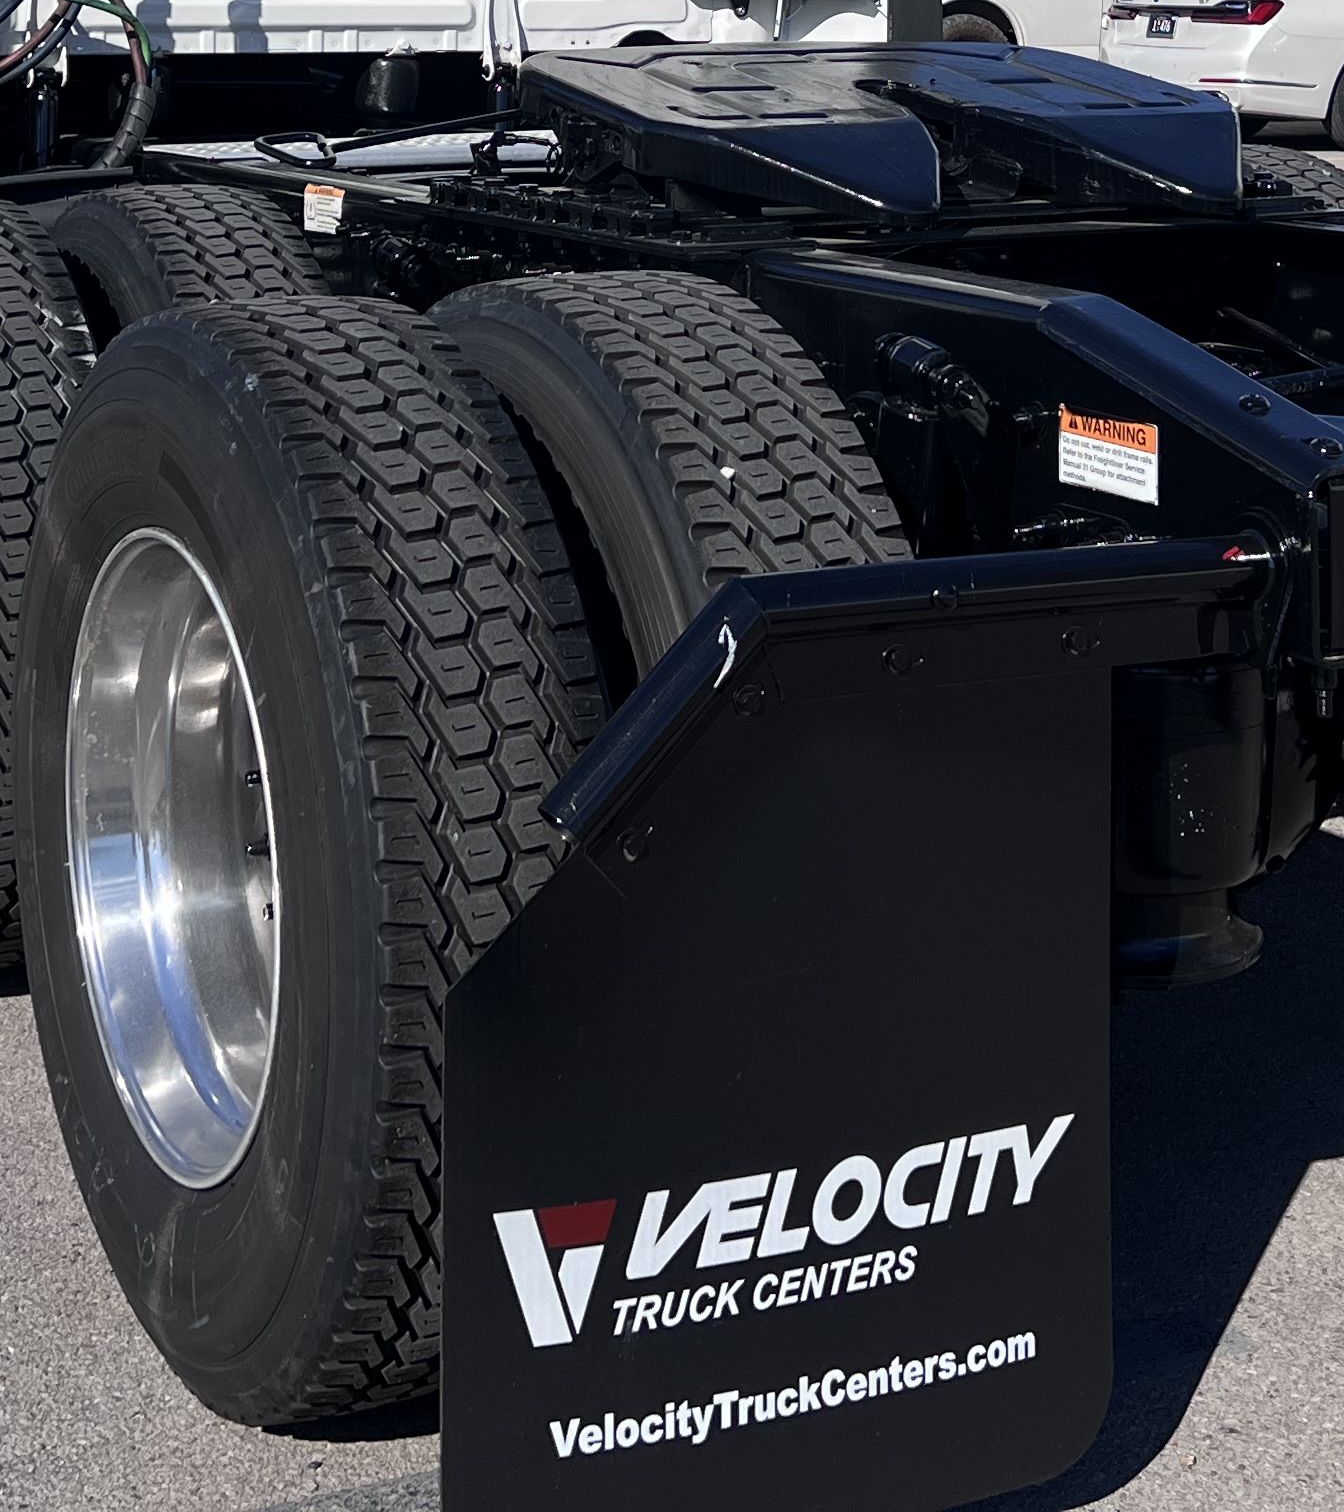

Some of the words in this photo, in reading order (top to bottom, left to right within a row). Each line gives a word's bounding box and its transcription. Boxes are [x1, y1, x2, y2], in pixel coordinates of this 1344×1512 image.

[1081, 416, 1146, 446] WARNING
[1062, 446, 1077, 456] Refer
[1077, 450, 1084, 458] to
[1084, 452, 1093, 461] the
[1093, 455, 1124, 469] Freightliner
[1125, 462, 1145, 474] Service
[1071, 438, 1080, 446] not
[1092, 443, 1104, 453] weld
[1112, 447, 1123, 457] drill
[1123, 450, 1139, 461] frame
[1062, 458, 1082, 469] Manual
[1089, 465, 1106, 477] Group
[1107, 469, 1115, 477] for
[1116, 472, 1146, 486] attachment
[625, 1113, 1075, 1280] VELOCITY
[611, 1278, 742, 1336] TRUCK
[752, 1245, 919, 1312] CENTERS
[549, 1328, 1037, 1458] VelocityTruckCenters.com
